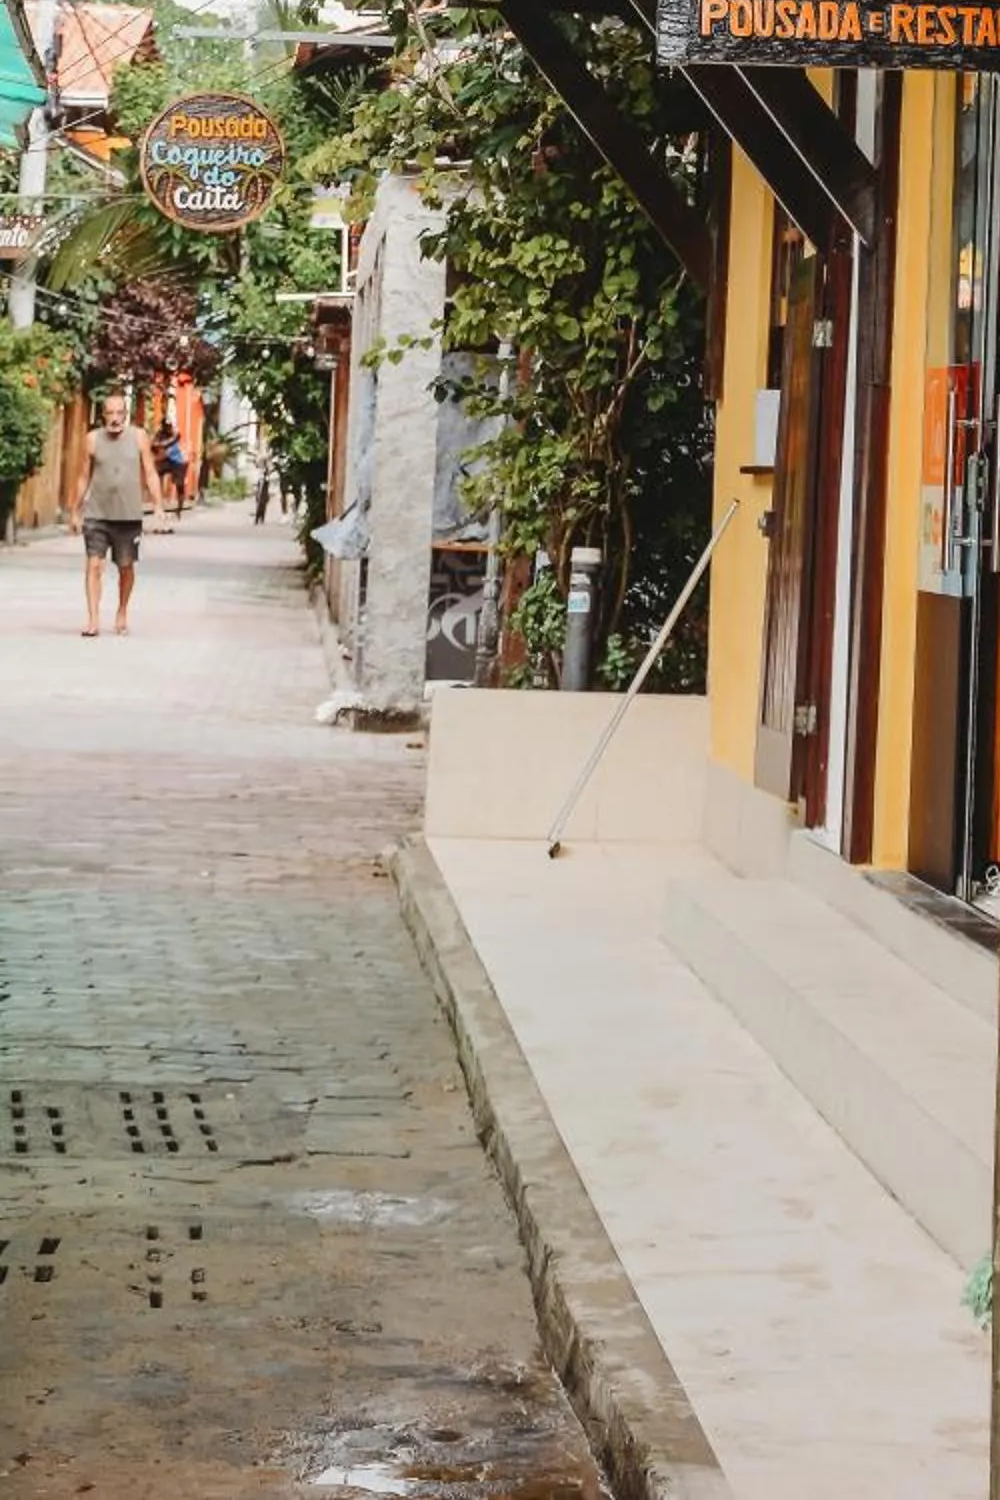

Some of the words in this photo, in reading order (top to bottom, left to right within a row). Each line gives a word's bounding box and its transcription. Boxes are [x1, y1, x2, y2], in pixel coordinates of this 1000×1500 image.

[169, 113, 268, 140] Pousada
[151, 140, 273, 181] Coqueiro
[203, 166, 243, 187] do
